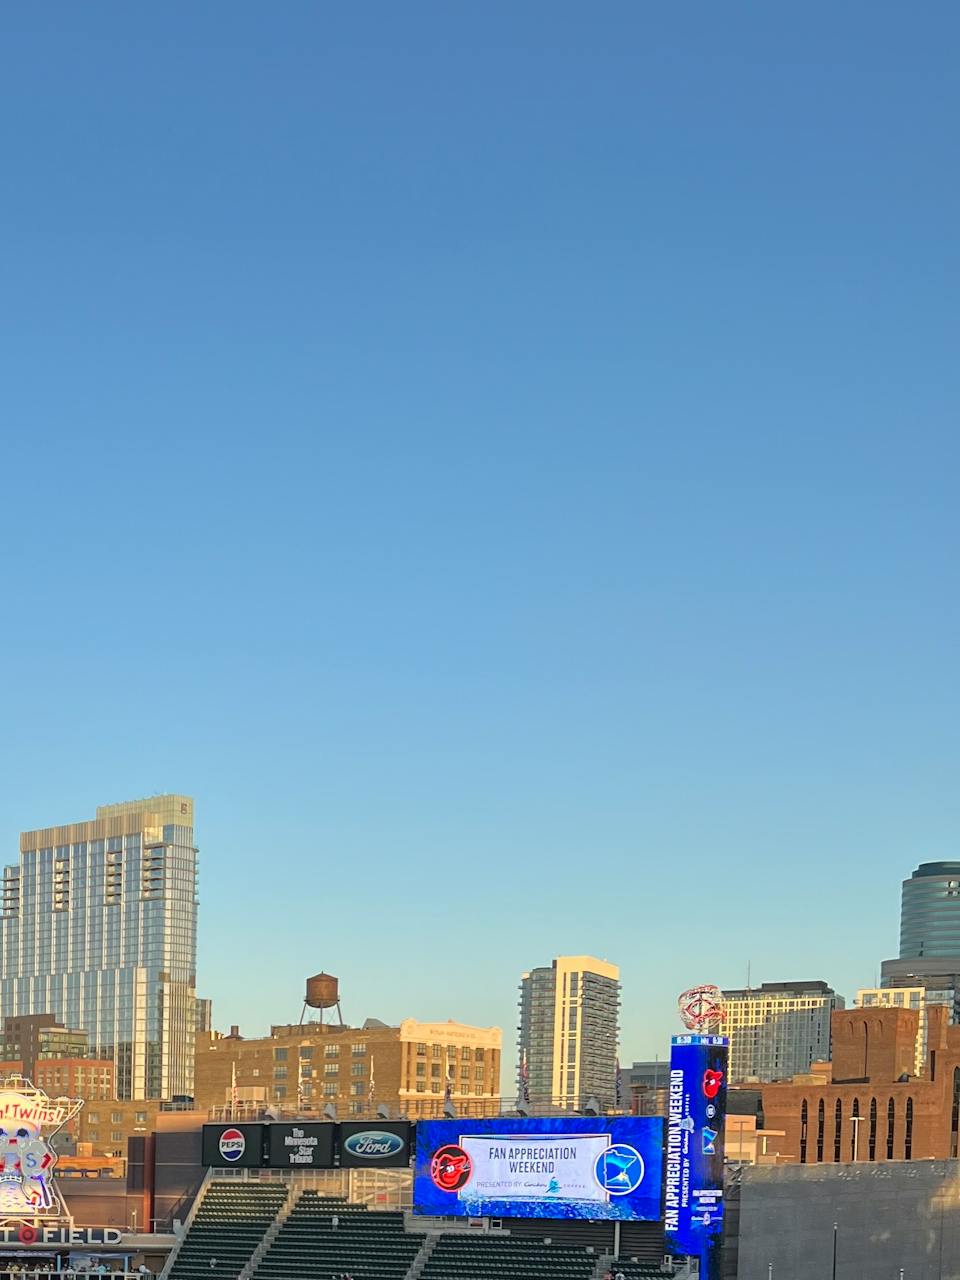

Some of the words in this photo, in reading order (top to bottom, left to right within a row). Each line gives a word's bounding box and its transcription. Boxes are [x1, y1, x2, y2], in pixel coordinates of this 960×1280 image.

[669, 1069, 683, 1125] WEEKEND
[12, 1103, 60, 1123] Twins!
[292, 1128, 304, 1137] The
[221, 1140, 243, 1149] PEPSI
[285, 1136, 318, 1146] Minnesota
[356, 1136, 392, 1153] Ford
[289, 1153, 313, 1163] Tribune
[299, 1147, 313, 1156] Star
[489, 1147, 506, 1160] FAN
[509, 1147, 577, 1160] APPRECIATION
[509, 1161, 555, 1174] WEEKEND
[667, 1127, 681, 1208] APPRECIATION
[665, 1210, 679, 1231] FAN
[43, 1228, 122, 1244] FIELD
